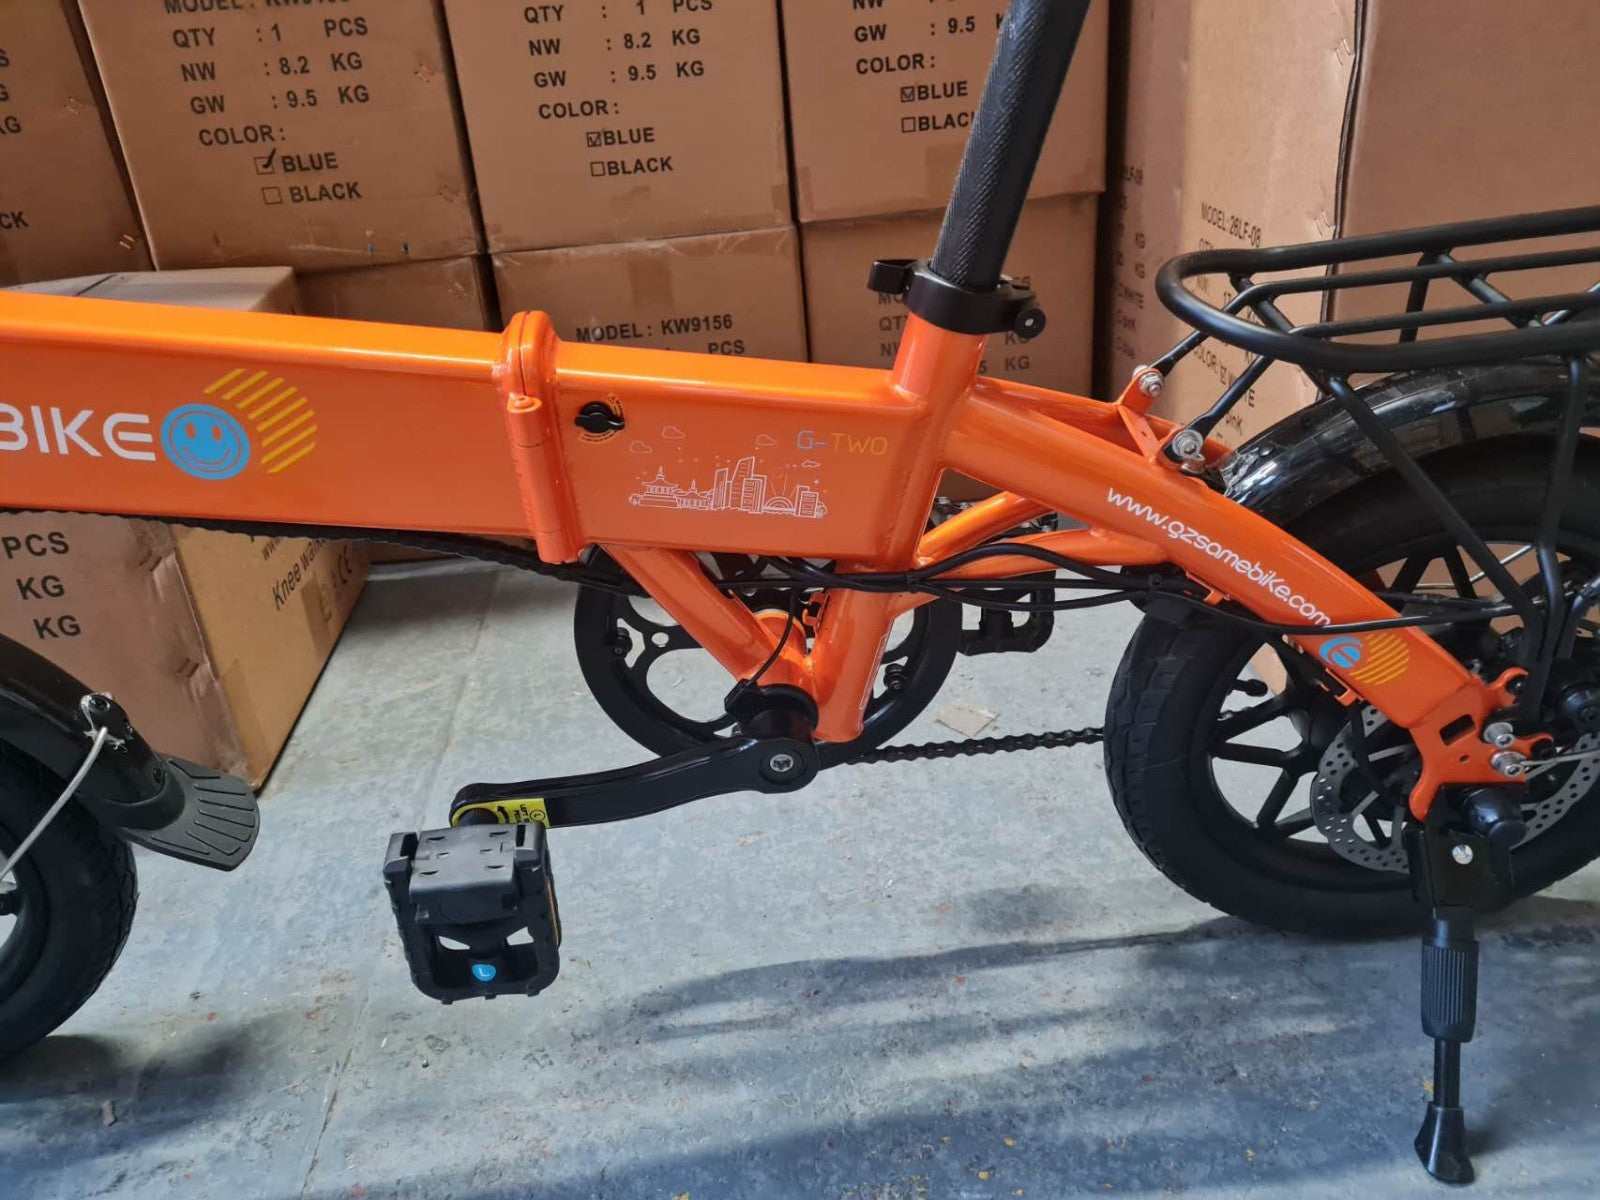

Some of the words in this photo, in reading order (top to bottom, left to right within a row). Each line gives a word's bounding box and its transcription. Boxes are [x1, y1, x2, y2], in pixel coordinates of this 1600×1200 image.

[524, 5, 563, 24] QTY
[637, 0, 644, 15] 1
[673, 0, 712, 13] PCS
[173, 27, 214, 48] QTY
[271, 23, 281, 41] 1
[324, 17, 368, 37] PCS
[855, 24, 886, 42] GW
[948, 16, 975, 34] 9.5
[529, 39, 560, 56] NW
[624, 32, 651, 49] 8.2
[672, 28, 700, 45] KG
[181, 62, 215, 82] NW
[279, 56, 310, 75] 8.2
[331, 52, 362, 71] KG
[534, 71, 566, 88] GW
[628, 64, 656, 81] 9.5
[676, 61, 704, 77] KG
[856, 53, 934, 74] COLOR:
[190, 96, 224, 114] GW
[286, 89, 317, 108] 9.5
[338, 85, 369, 104] KG
[917, 81, 967, 100] BLUE
[539, 100, 619, 119] COLOR:
[917, 111, 975, 132] BLAC
[199, 125, 285, 146] COLOR:
[602, 127, 654, 145] BLUE
[281, 152, 338, 172] BLUE
[607, 156, 673, 175] BLACK
[289, 182, 362, 203] BLACK
[576, 322, 653, 342] MODEL:
[661, 314, 732, 335] KW9156
[708, 340, 745, 355] PCS
[1005, 356, 1029, 371] KG
[2, 532, 69, 559] PCS
[16, 575, 65, 600] KG
[272, 562, 301, 611] Knee
[33, 615, 81, 639] KG
